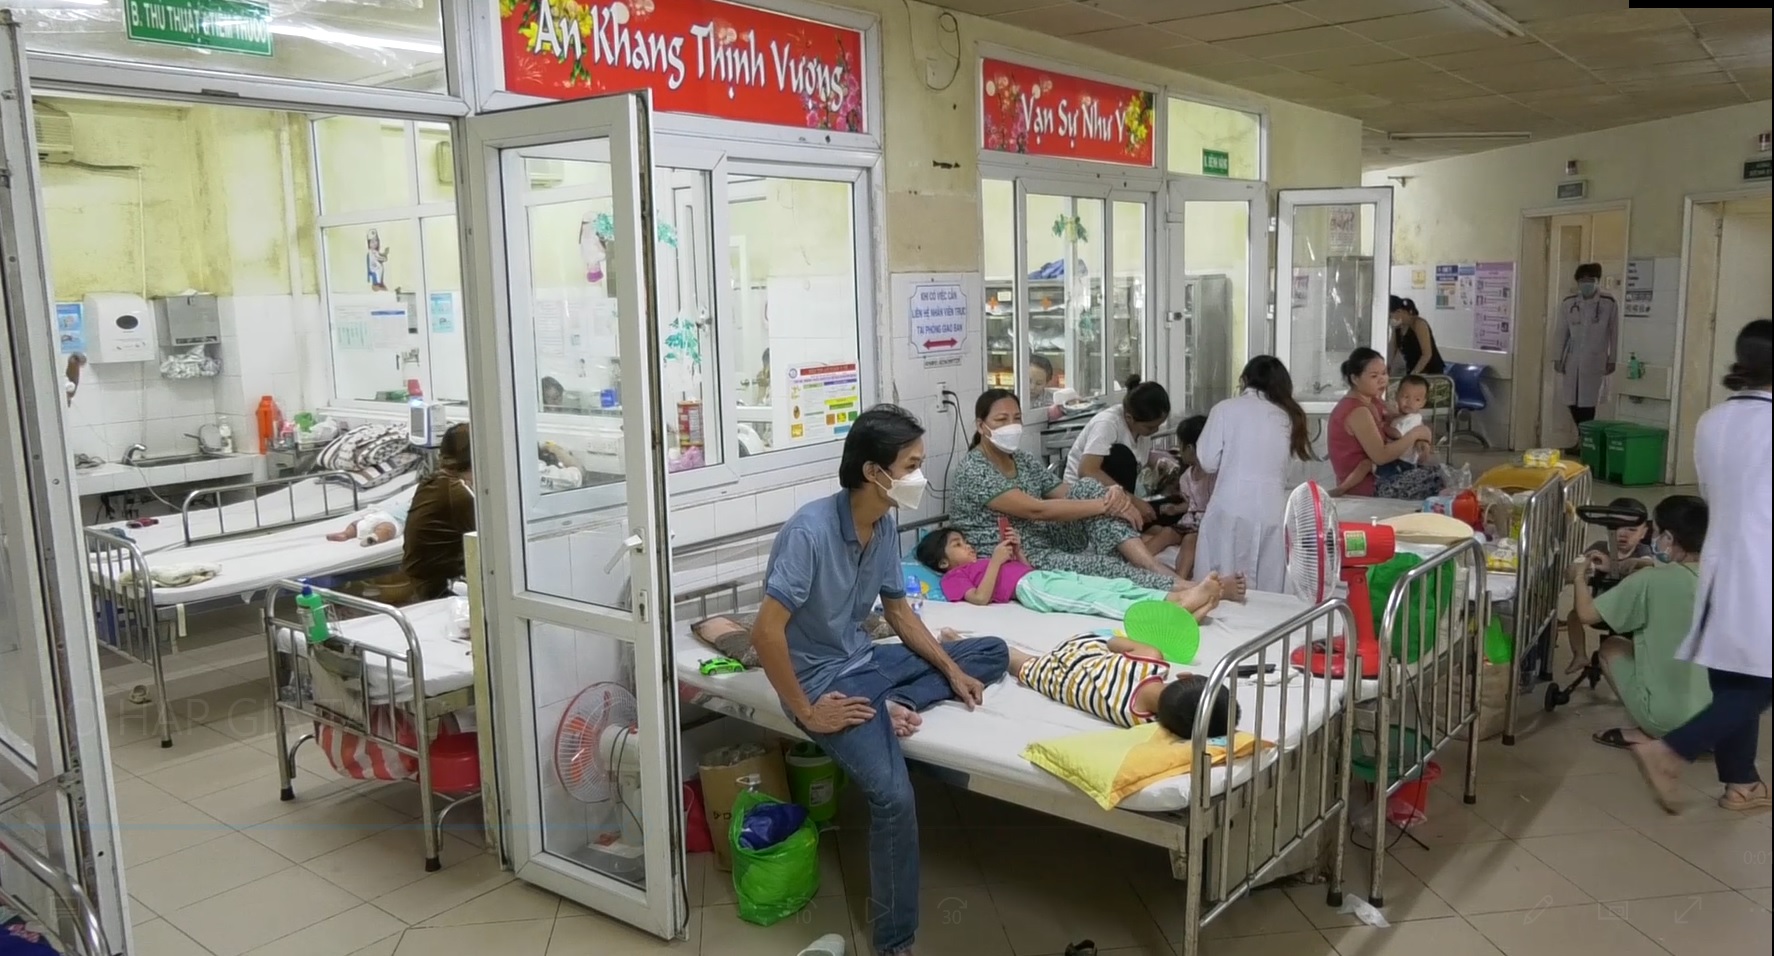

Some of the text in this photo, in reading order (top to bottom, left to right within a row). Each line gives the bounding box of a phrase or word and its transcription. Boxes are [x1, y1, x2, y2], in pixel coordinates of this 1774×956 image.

[533, 0, 844, 112] An Khang Thịnh Vượng
[1020, 93, 1126, 148] Vạn Sự Như Ý
